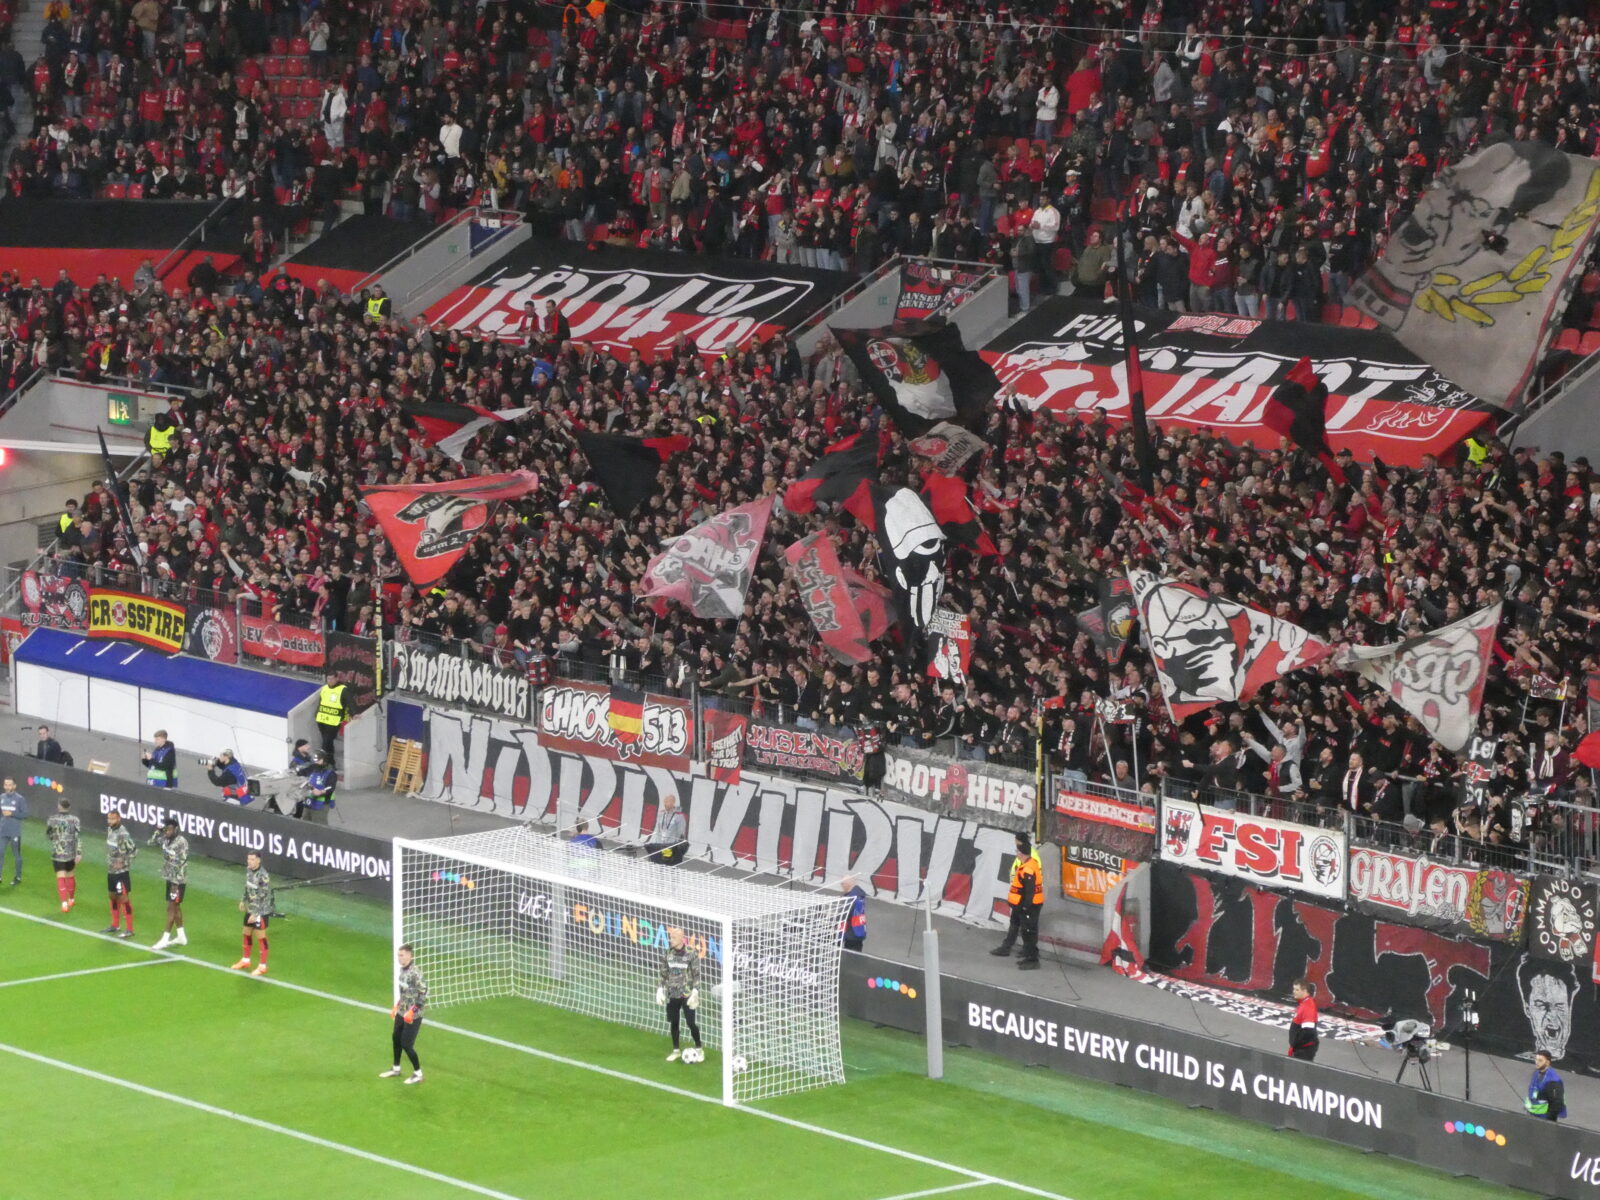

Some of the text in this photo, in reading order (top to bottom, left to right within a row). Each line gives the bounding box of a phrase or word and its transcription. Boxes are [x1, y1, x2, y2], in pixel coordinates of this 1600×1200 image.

[91, 599, 184, 641] CROSSFIRE
[283, 636, 322, 653] addicts
[543, 686, 688, 756] CHAOS 513
[100, 794, 165, 829] BECAUSE
[218, 822, 264, 850] CHILD
[268, 834, 282, 855] IS
[286, 838, 298, 858] A
[302, 841, 391, 879] CHAMPION
[423, 710, 1014, 925] NORDKURVE
[1195, 813, 1303, 881] FSI
[1082, 847, 1123, 868] RESPECT
[519, 891, 569, 925] UEF
[572, 902, 725, 966] FOUNDAON
[1536, 879, 1595, 955] COMMANDO 1989
[968, 1002, 1382, 1129] BECAUSE EVERY CHILD IS A CHAMPION
